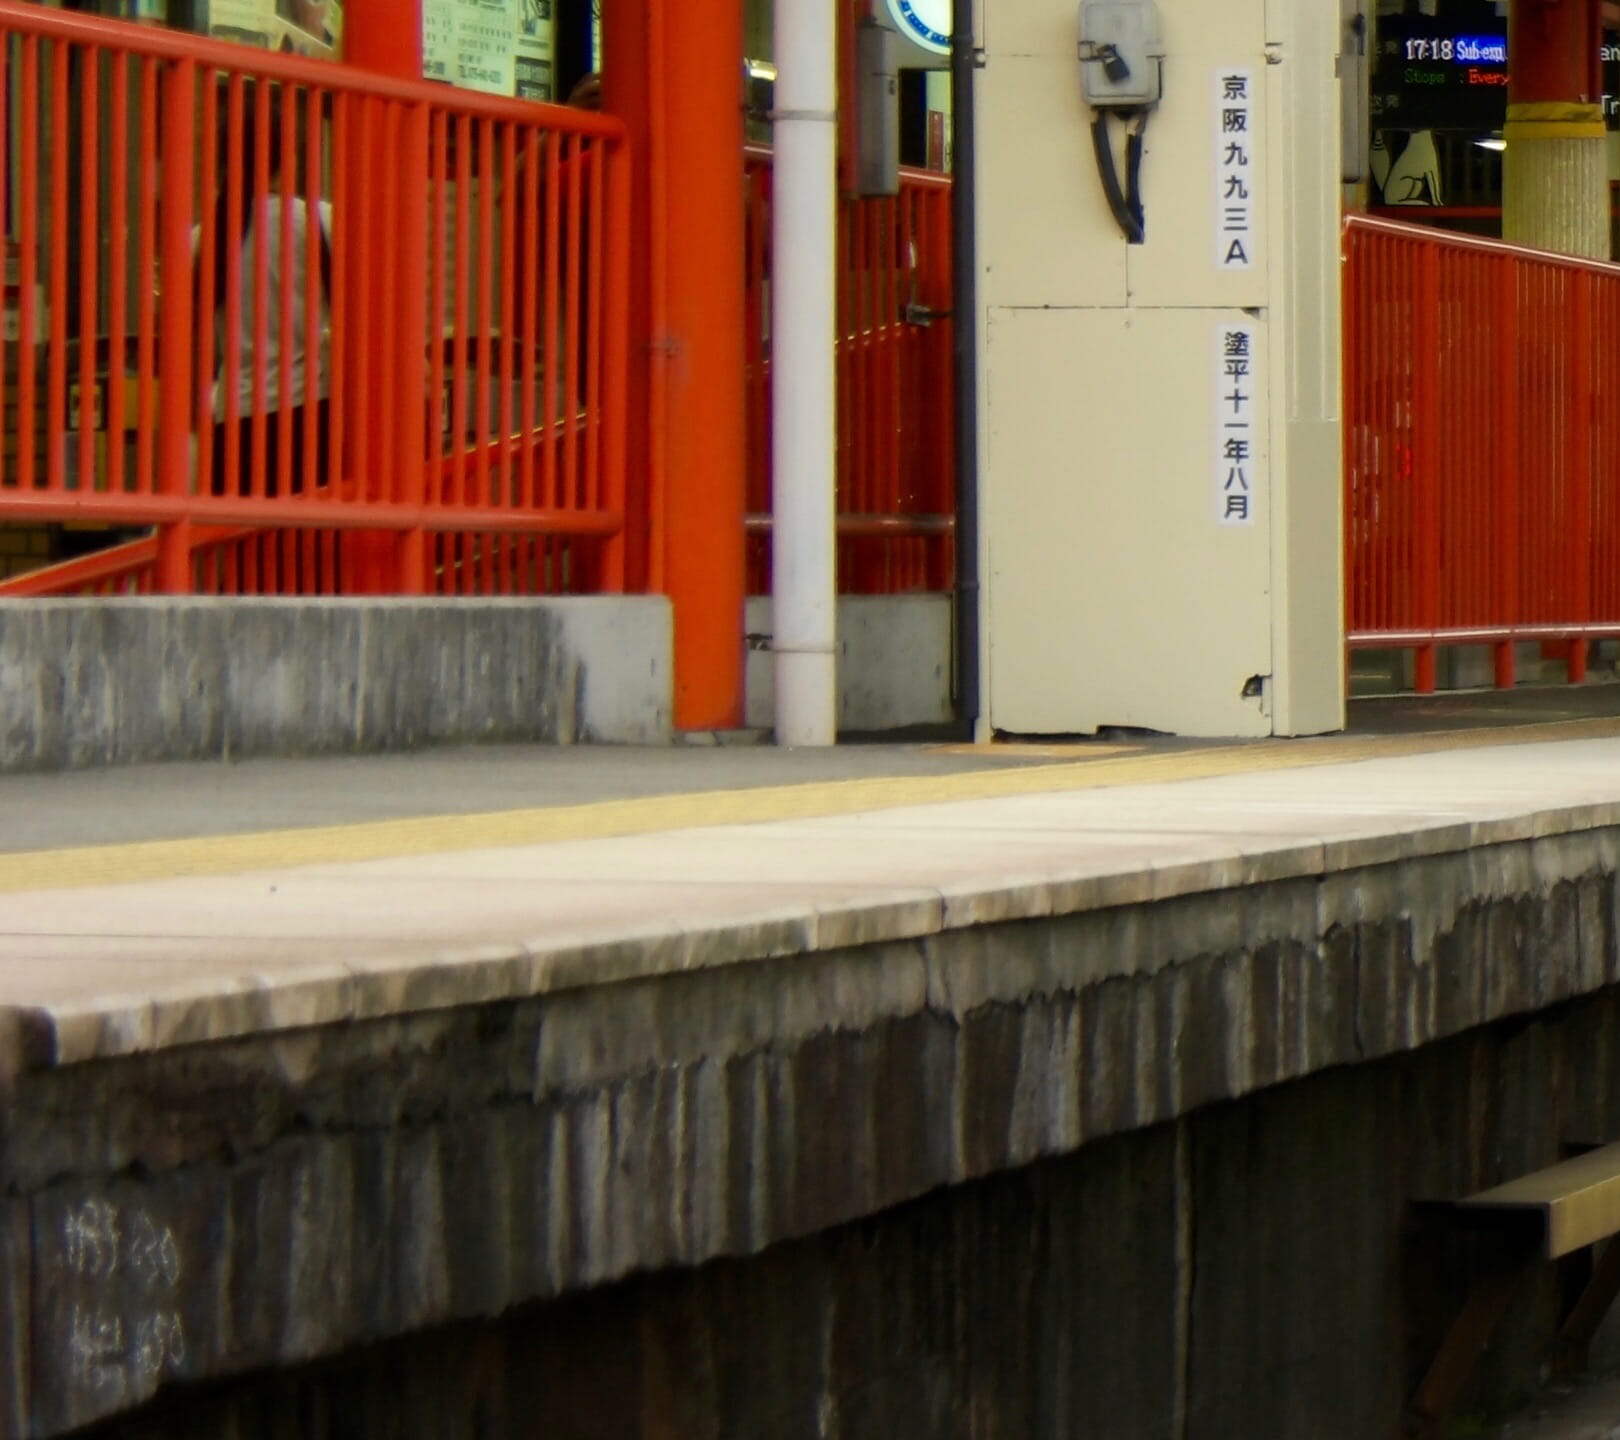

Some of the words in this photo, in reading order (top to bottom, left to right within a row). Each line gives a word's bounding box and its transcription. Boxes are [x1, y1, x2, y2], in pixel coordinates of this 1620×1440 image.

[1405, 40, 1455, 60] 17:18
[1221, 75, 1249, 265] 京阪九九三A
[1222, 330, 1250, 520] 塗平十一年八月
